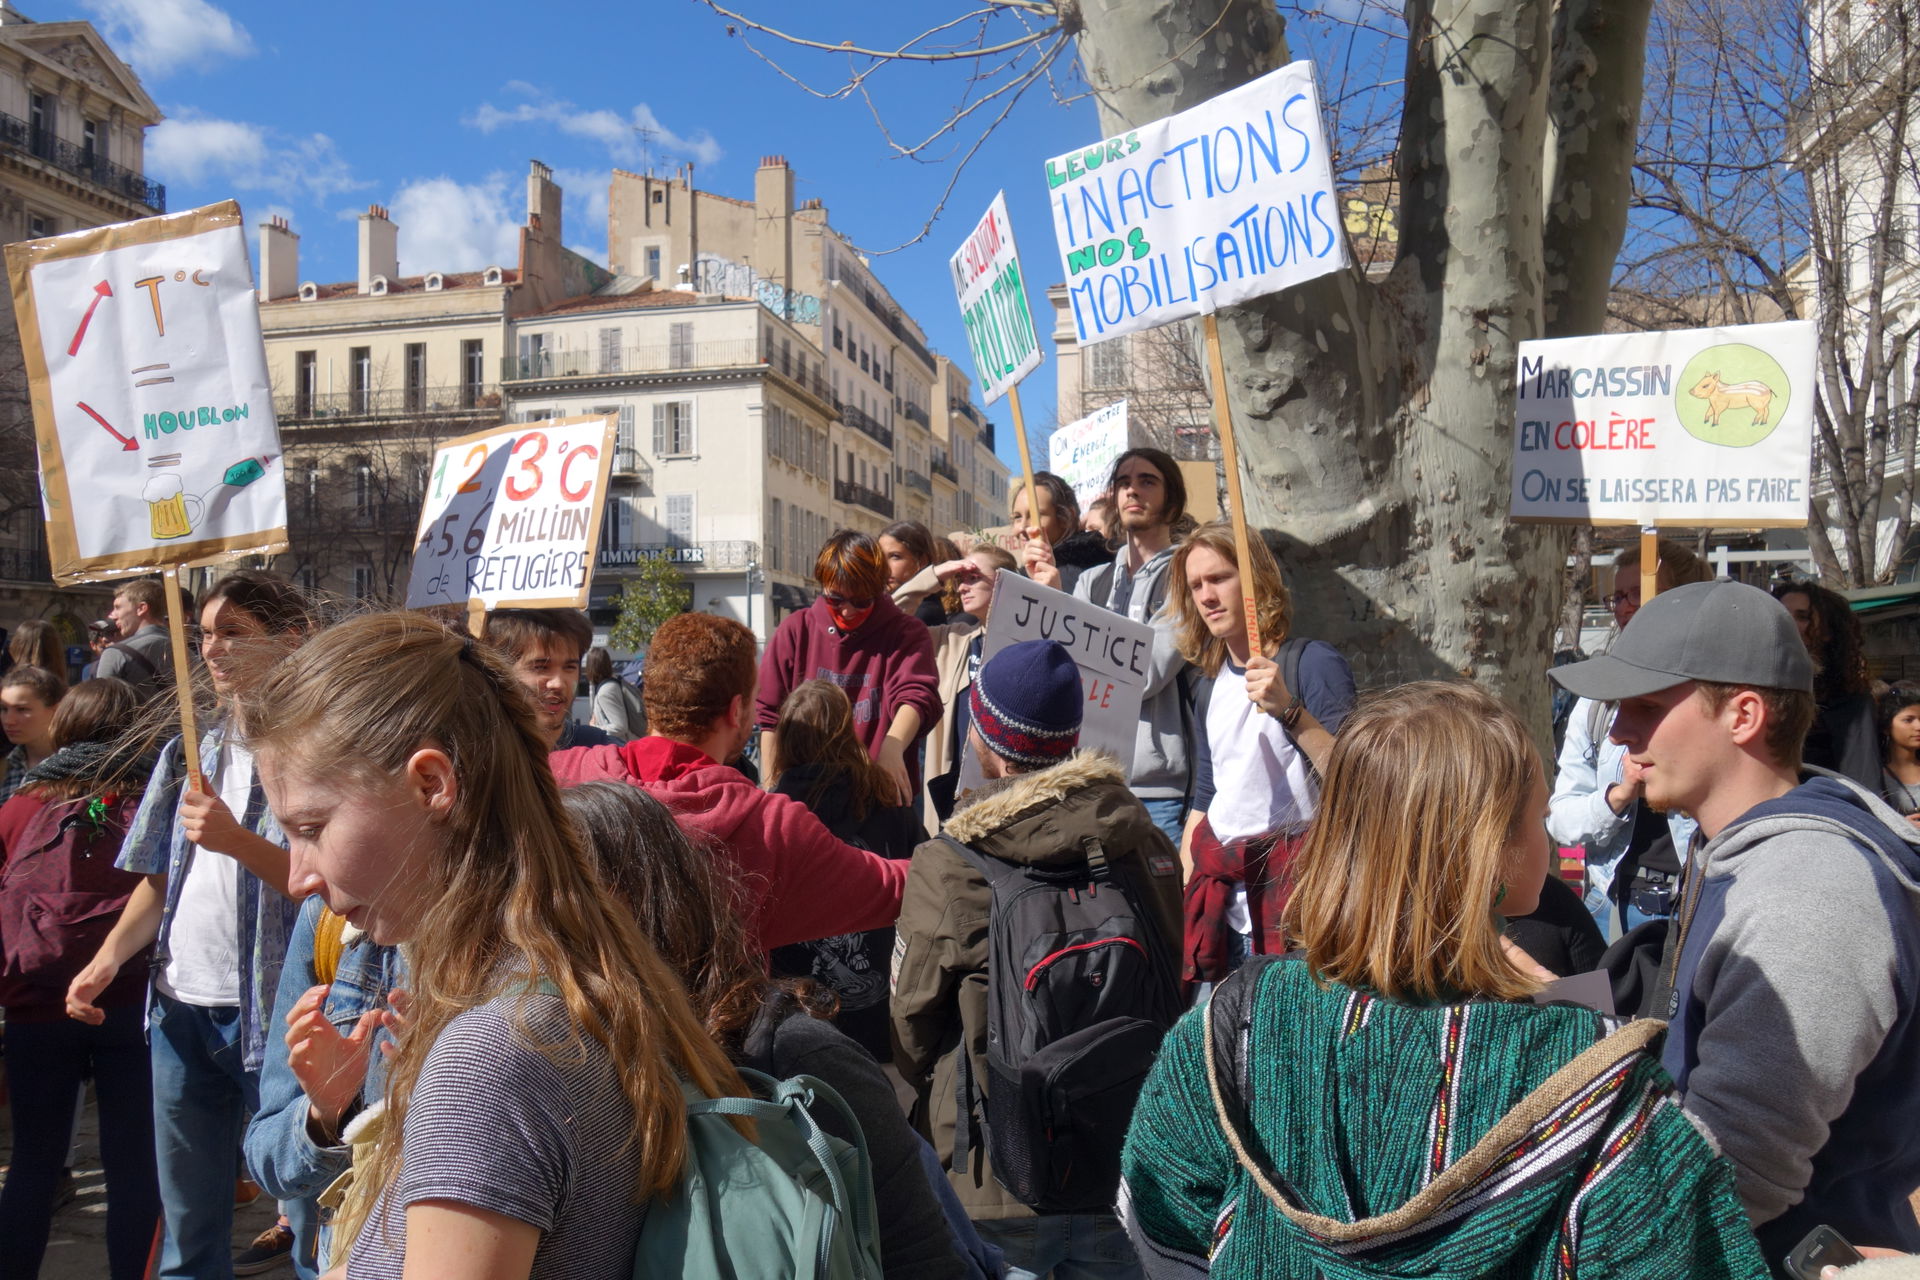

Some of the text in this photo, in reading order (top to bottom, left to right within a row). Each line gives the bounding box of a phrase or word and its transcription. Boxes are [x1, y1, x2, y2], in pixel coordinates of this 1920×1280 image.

[1046, 132, 1141, 189] LEURS
[1061, 93, 1311, 247] INACTIONS
[1067, 226, 1151, 276] NOS
[1070, 190, 1336, 340] MOBILISATIONS
[144, 403, 249, 439] HOUBLON
[1520, 411, 1656, 451] EN COLÈRE
[1566, 479, 1591, 503] SE
[1706, 478, 1741, 503] PAS
[427, 563, 449, 595] de
